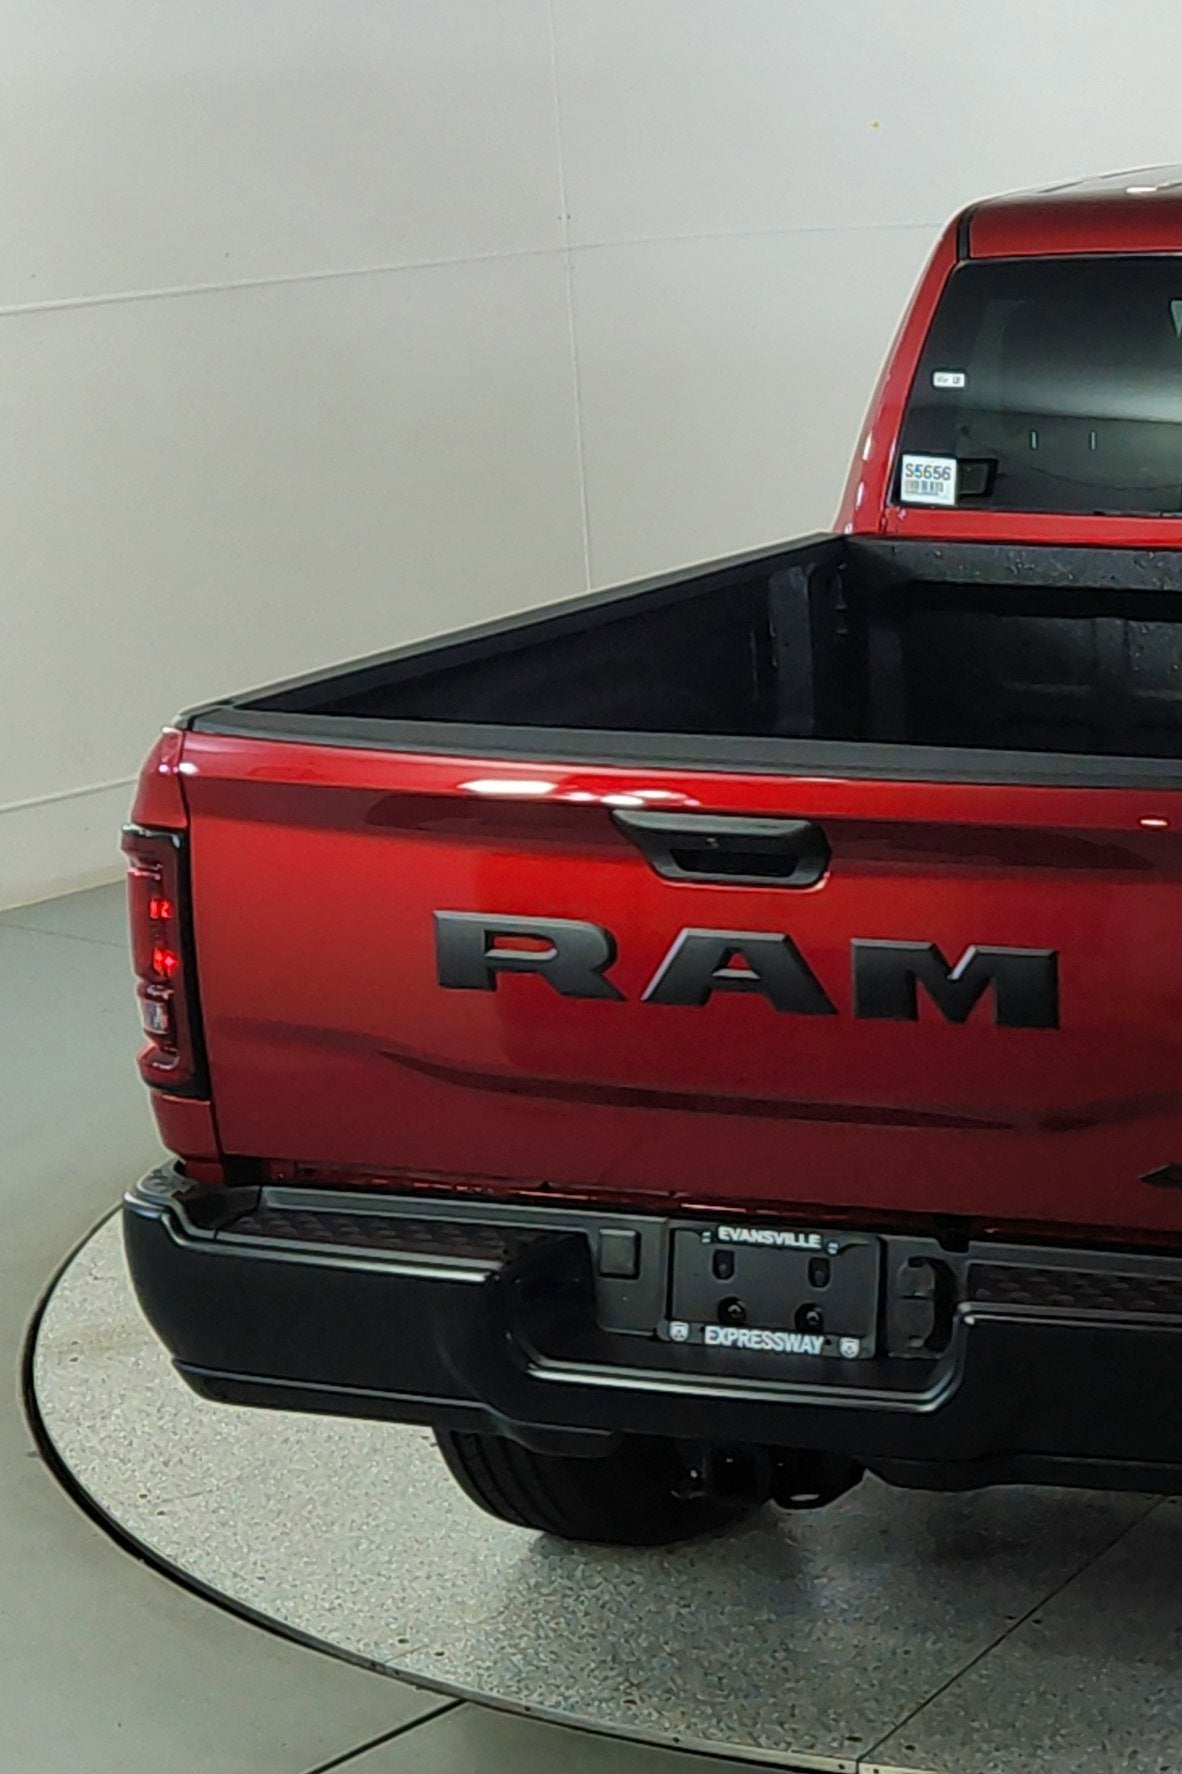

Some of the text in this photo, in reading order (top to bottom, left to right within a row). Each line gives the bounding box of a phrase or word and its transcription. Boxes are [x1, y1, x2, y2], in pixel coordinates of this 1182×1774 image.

[905, 463, 952, 481] S5656
[433, 910, 1060, 1030] RAM
[718, 1226, 821, 1249] EVANSVILLE
[705, 1325, 824, 1354] EXPRESSWAY
